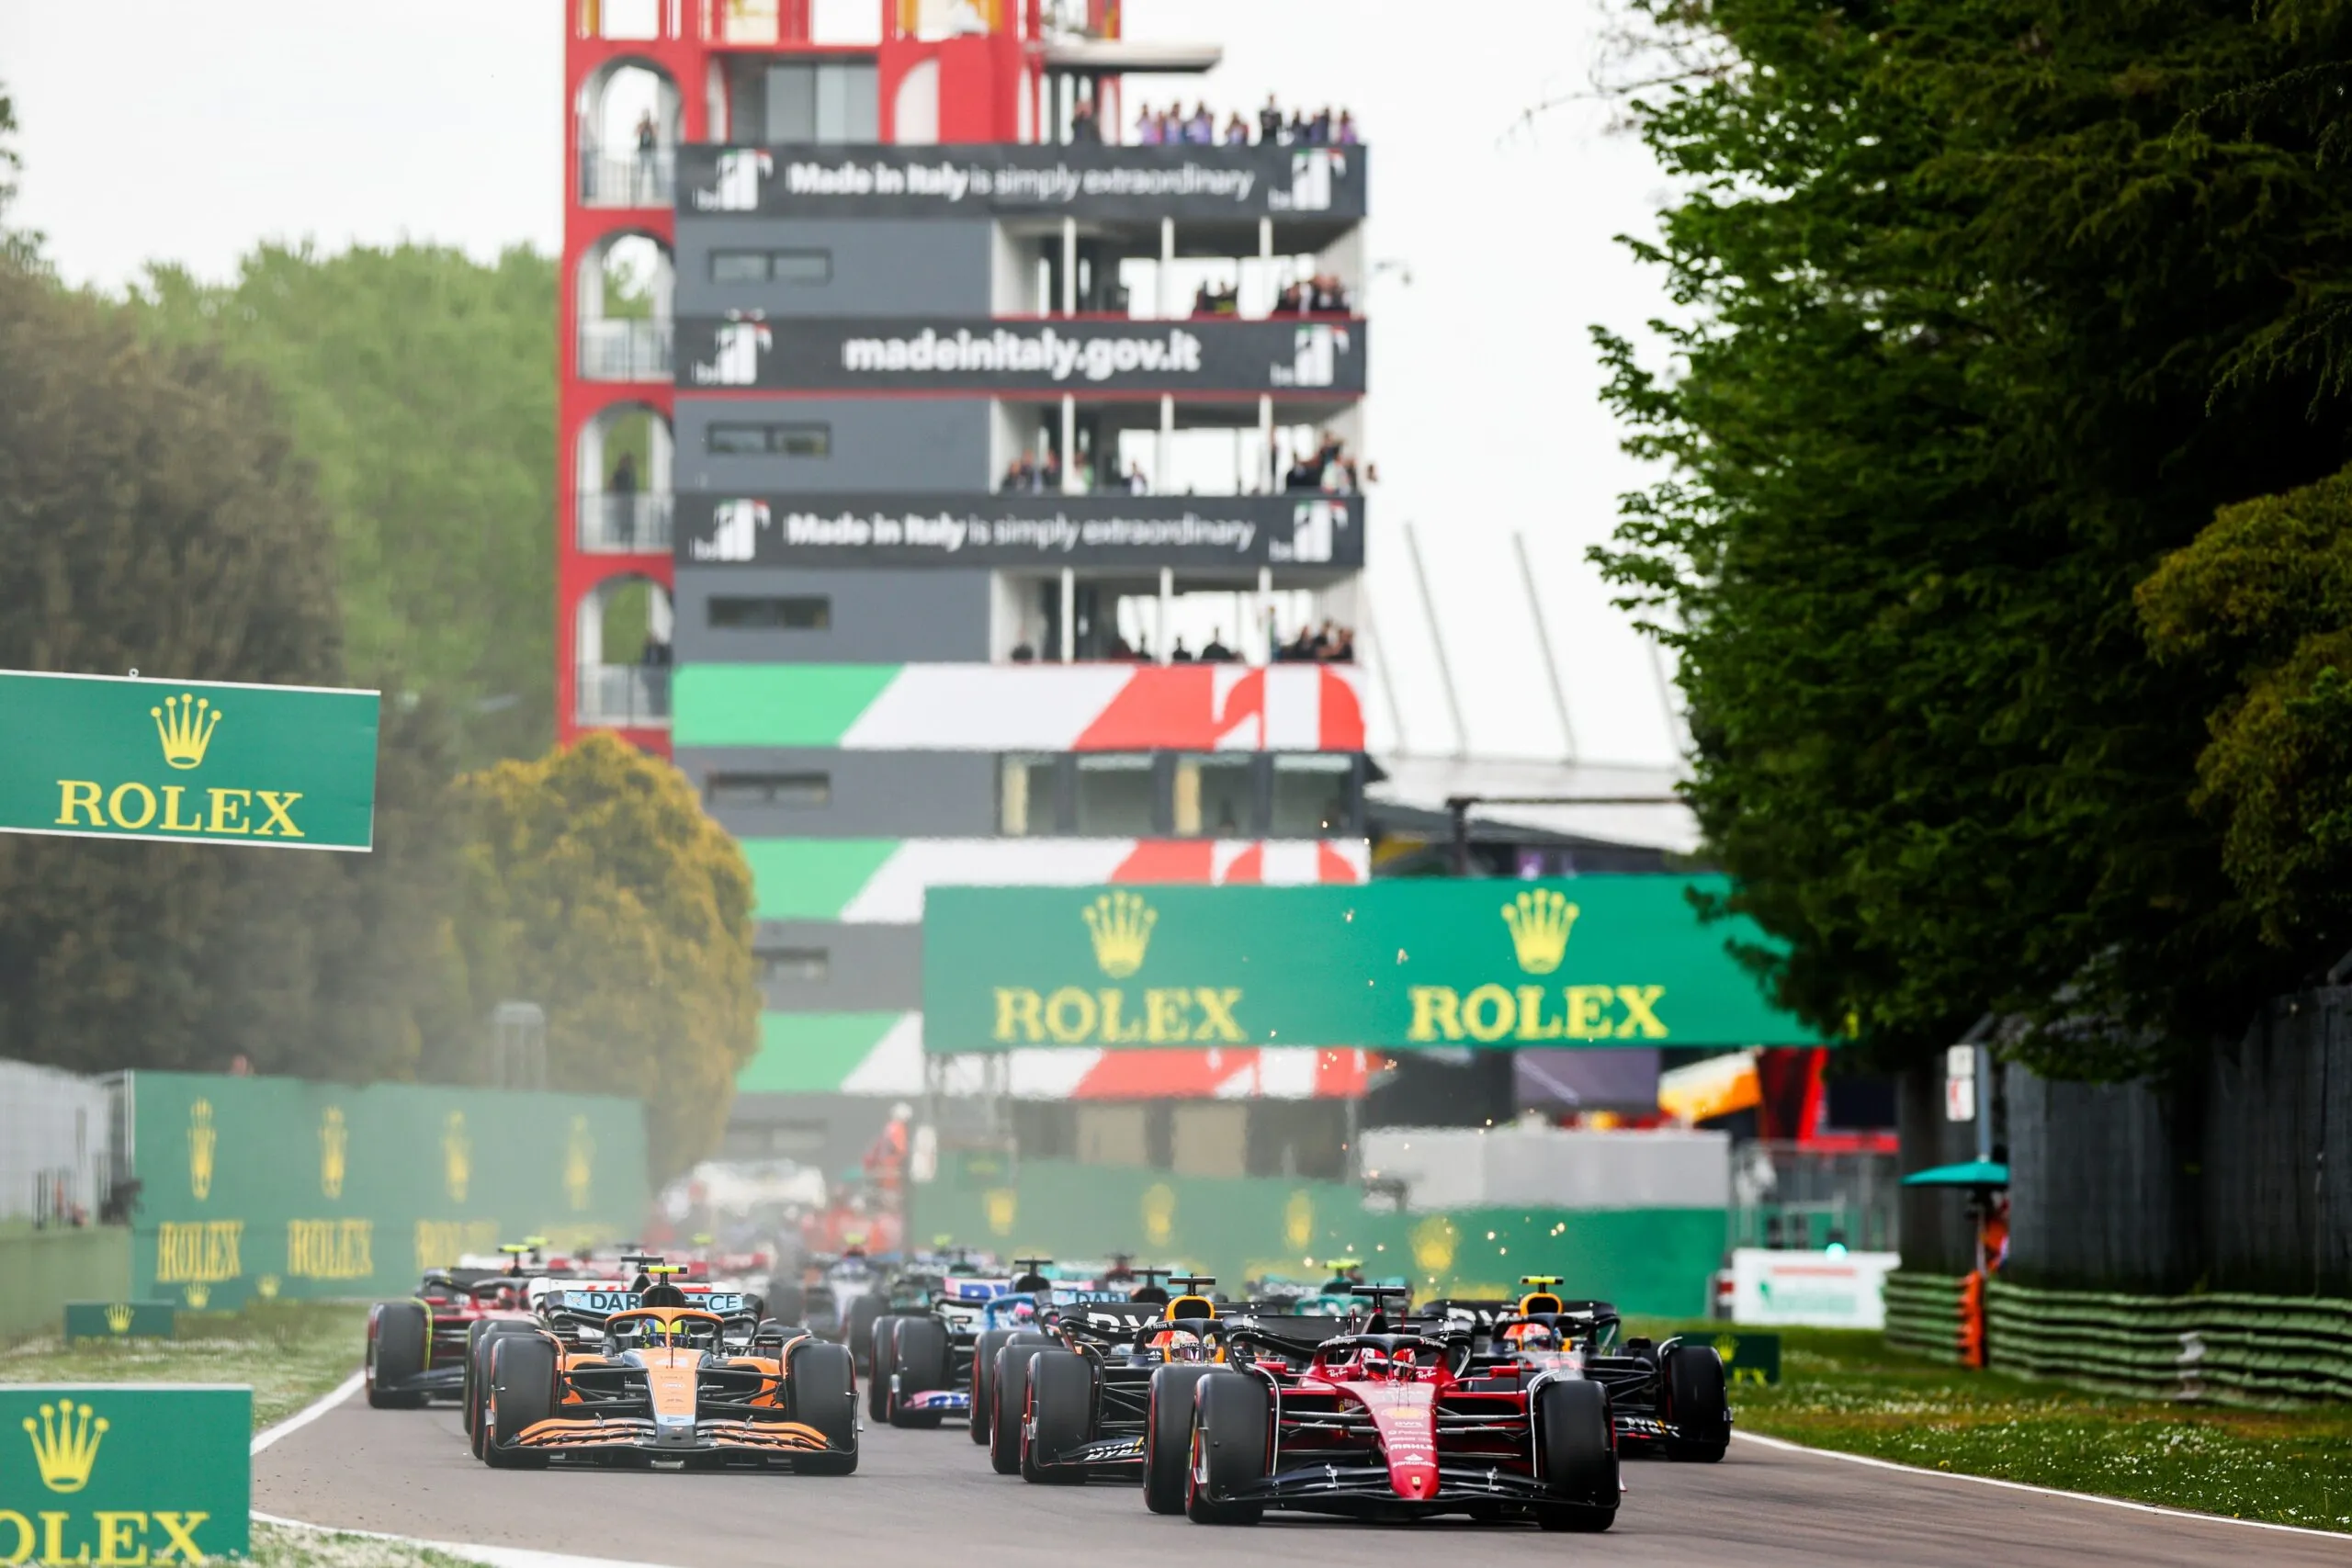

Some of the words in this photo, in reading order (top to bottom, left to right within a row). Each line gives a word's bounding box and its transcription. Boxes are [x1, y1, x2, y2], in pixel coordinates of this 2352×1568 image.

[787, 163, 873, 195] Made
[875, 163, 904, 195] in
[907, 162, 969, 201] Italy
[970, 164, 992, 195] is
[994, 164, 1081, 201] simply
[1083, 164, 1255, 201] extraordinary
[842, 328, 1201, 380] madeinitaly.gov.it
[786, 513, 871, 546] Made
[872, 514, 901, 545] in
[904, 513, 967, 552] Italy
[969, 516, 991, 547] is
[993, 515, 1080, 551] simply
[1082, 515, 1255, 551] extraordinary
[55, 780, 305, 838] ROLEX
[993, 988, 1244, 1043] ROLEX
[1409, 985, 1668, 1041] ROLEX
[590, 1292, 739, 1312] DARACE
[0, 1509, 210, 1565] OLEX
